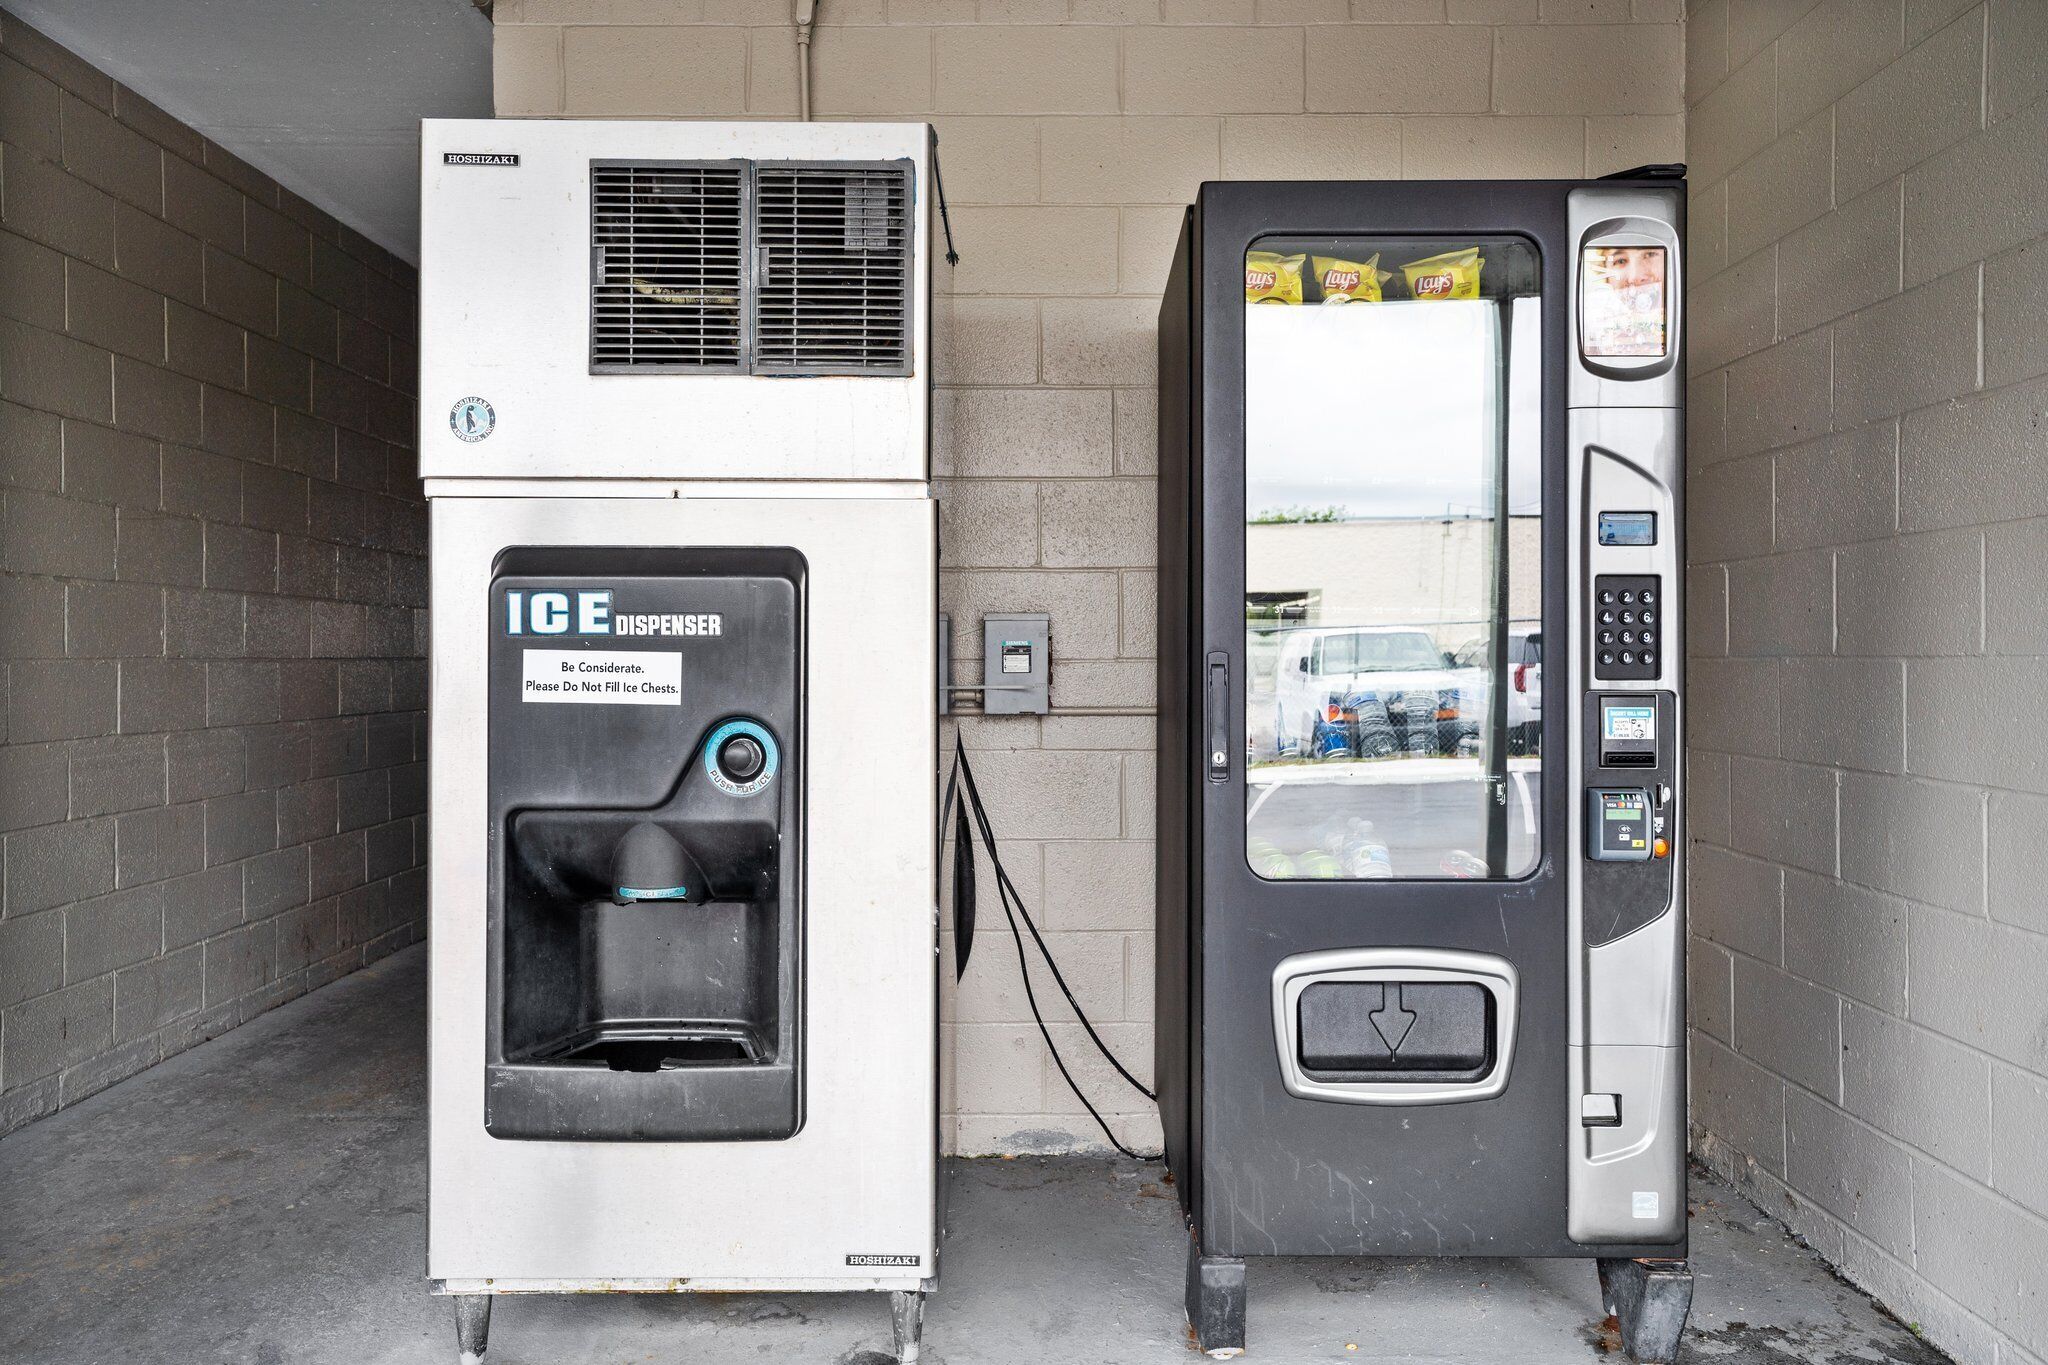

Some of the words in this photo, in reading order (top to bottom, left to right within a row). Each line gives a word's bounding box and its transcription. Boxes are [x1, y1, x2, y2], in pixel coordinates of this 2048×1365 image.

[447, 154, 515, 165] HOSHIZAKI
[1325, 270, 1360, 291] Lay's
[1417, 272, 1452, 295] Lay's
[1603, 592, 1609, 602] 1
[1623, 592, 1630, 602] 2
[1643, 592, 1651, 602] 3
[508, 592, 610, 635] ICE
[615, 614, 722, 636] DISPENSER
[1603, 612, 1610, 622] 4
[1623, 612, 1630, 622] 5
[1643, 612, 1651, 622] 6
[1603, 633, 1609, 643] 7
[1623, 632, 1630, 642] 8
[1643, 632, 1651, 642] 9
[1623, 652, 1630, 663] 0
[561, 661, 575, 672] Be
[578, 662, 645, 674] Considerate.
[526, 680, 560, 691] Please
[563, 681, 578, 692] Do
[581, 681, 602, 692] Not
[605, 681, 620, 692] Fill
[623, 682, 638, 693] Ice
[641, 682, 679, 694] Chests.
[709, 769, 733, 792] PUSH
[757, 772, 771, 787] ICE
[849, 1255, 917, 1266] HOSHIZAKI
